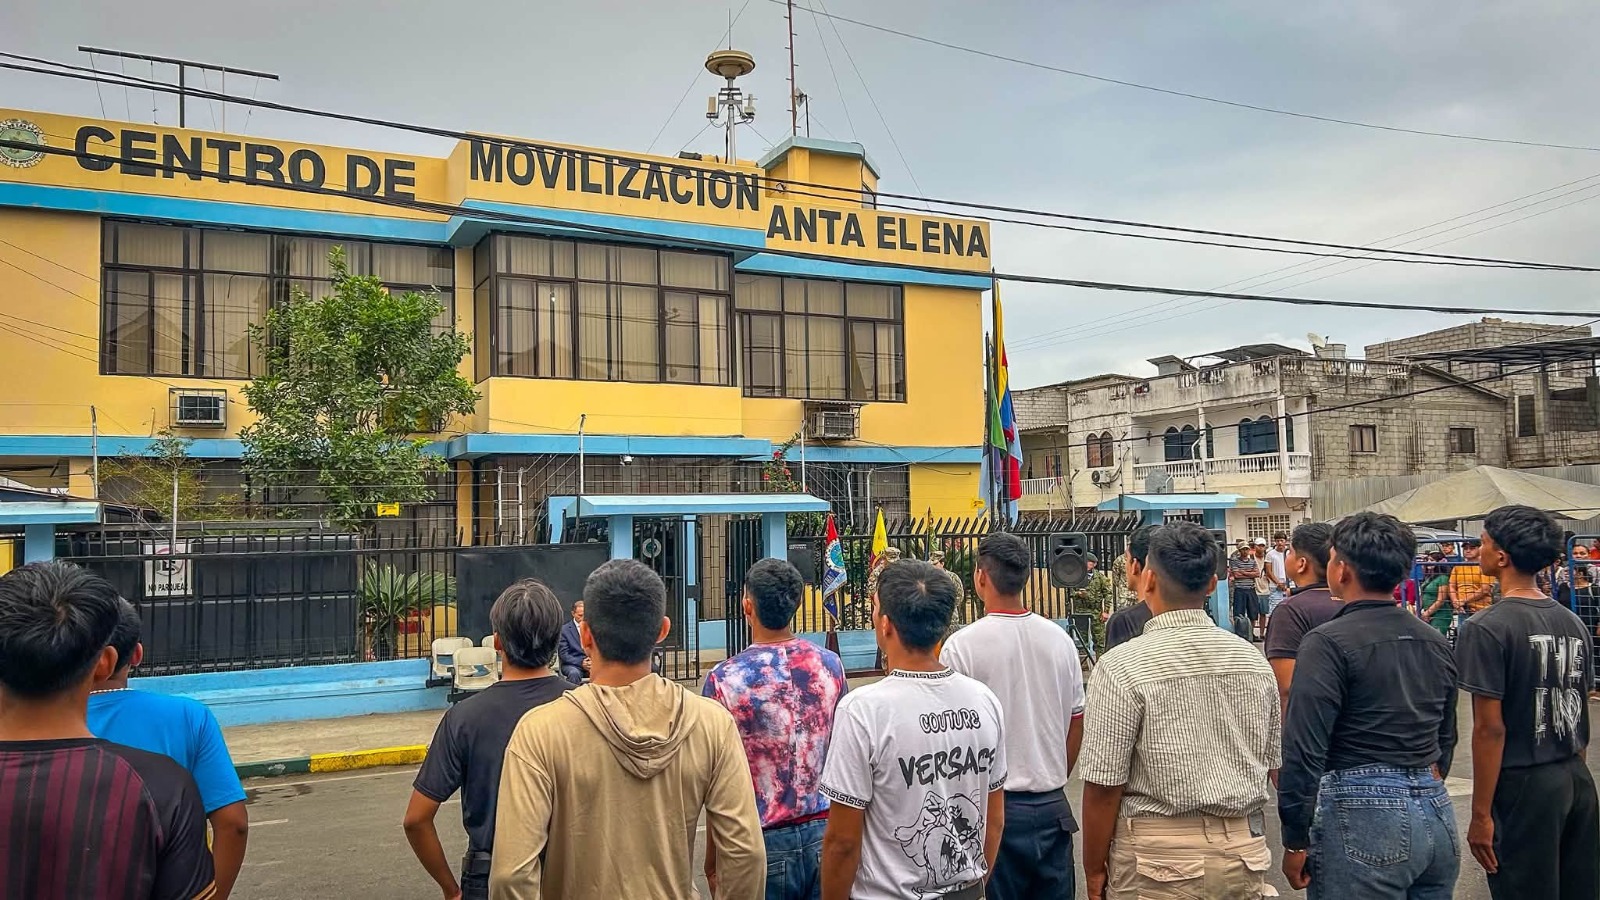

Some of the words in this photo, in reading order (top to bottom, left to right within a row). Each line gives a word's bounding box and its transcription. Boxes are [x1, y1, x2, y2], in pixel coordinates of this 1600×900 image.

[75, 126, 326, 190] CENTRO
[347, 154, 416, 201] DE
[470, 138, 759, 211] MOVILIZACION
[877, 215, 988, 258] ELENA
[1528, 634, 1584, 688] THE
[919, 708, 981, 733] COUTURE
